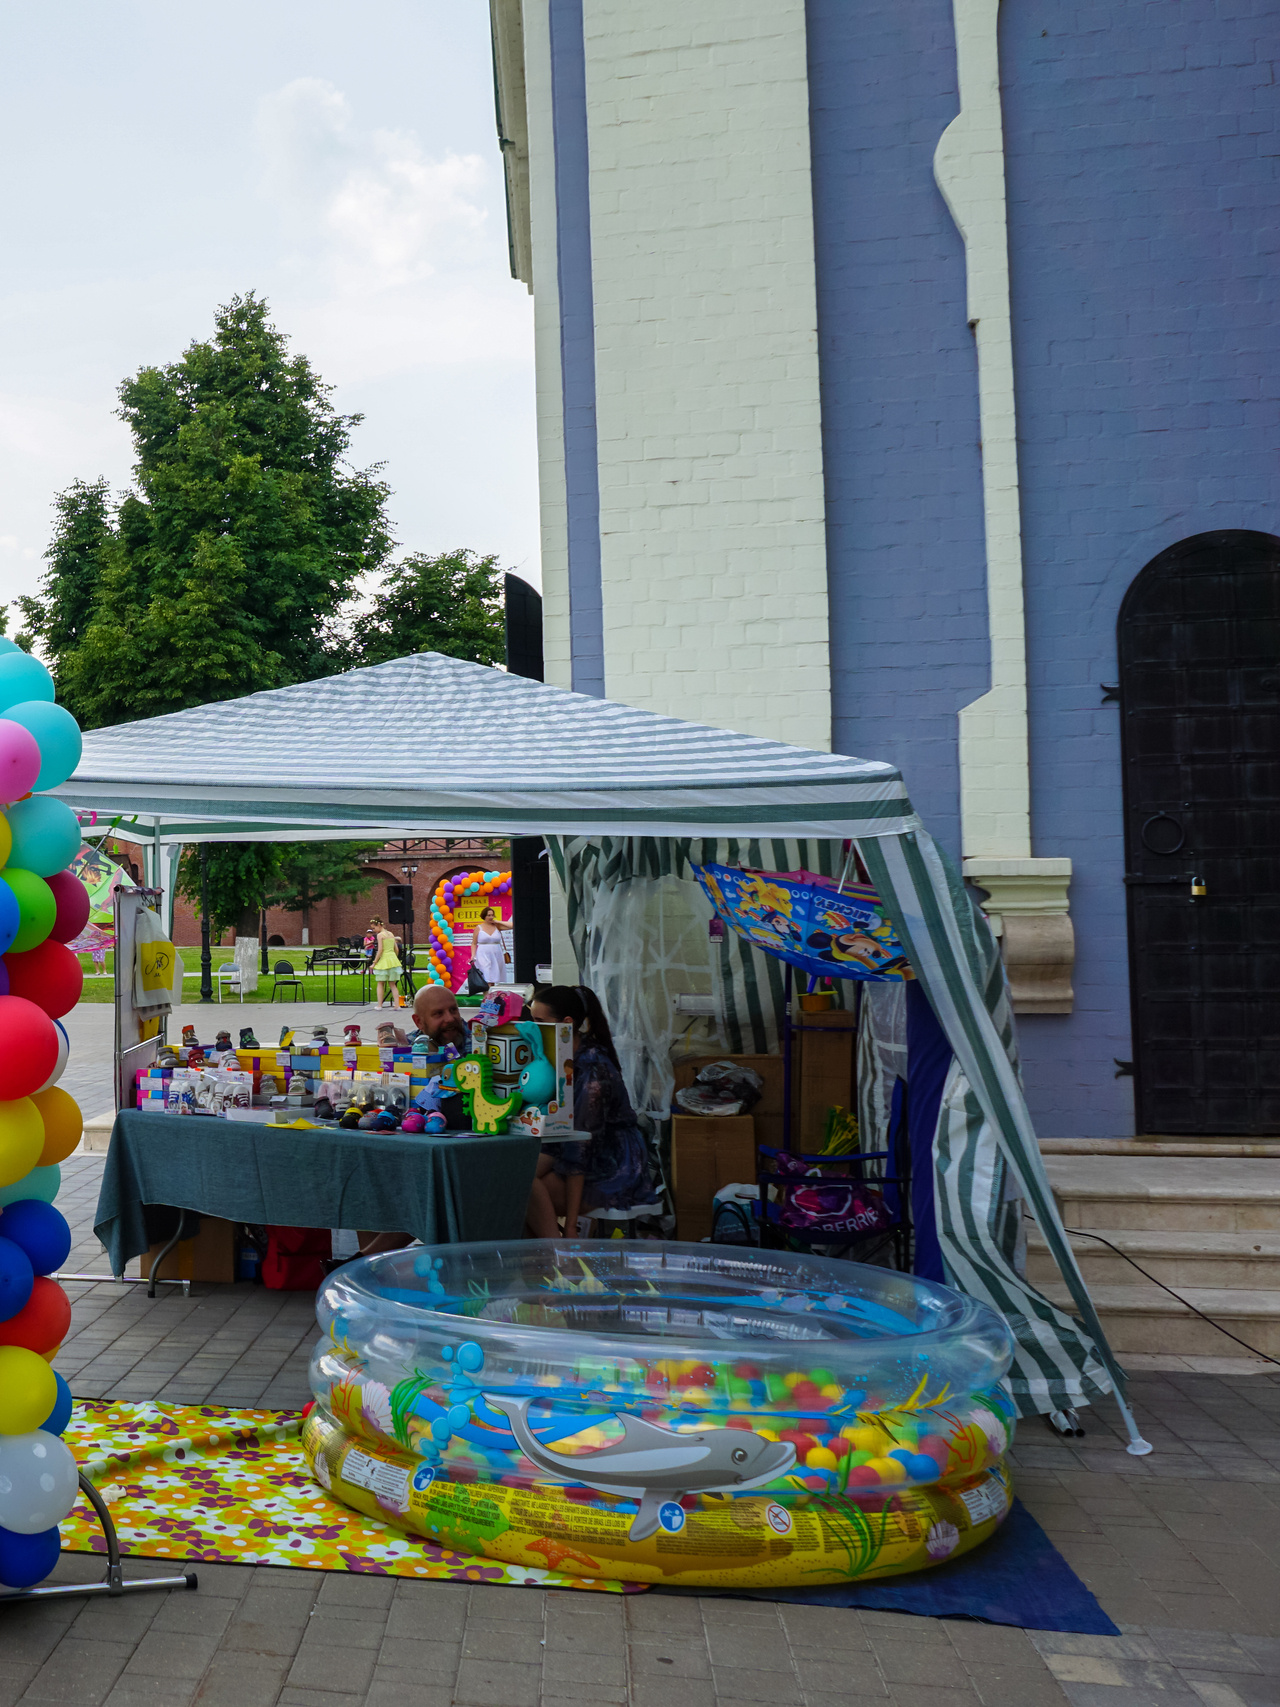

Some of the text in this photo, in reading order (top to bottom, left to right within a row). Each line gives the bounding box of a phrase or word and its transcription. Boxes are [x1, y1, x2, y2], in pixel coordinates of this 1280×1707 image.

[457, 910, 480, 920] СЦЕ
[815, 898, 872, 922] MICKEY
[489, 1044, 528, 1065] B C
